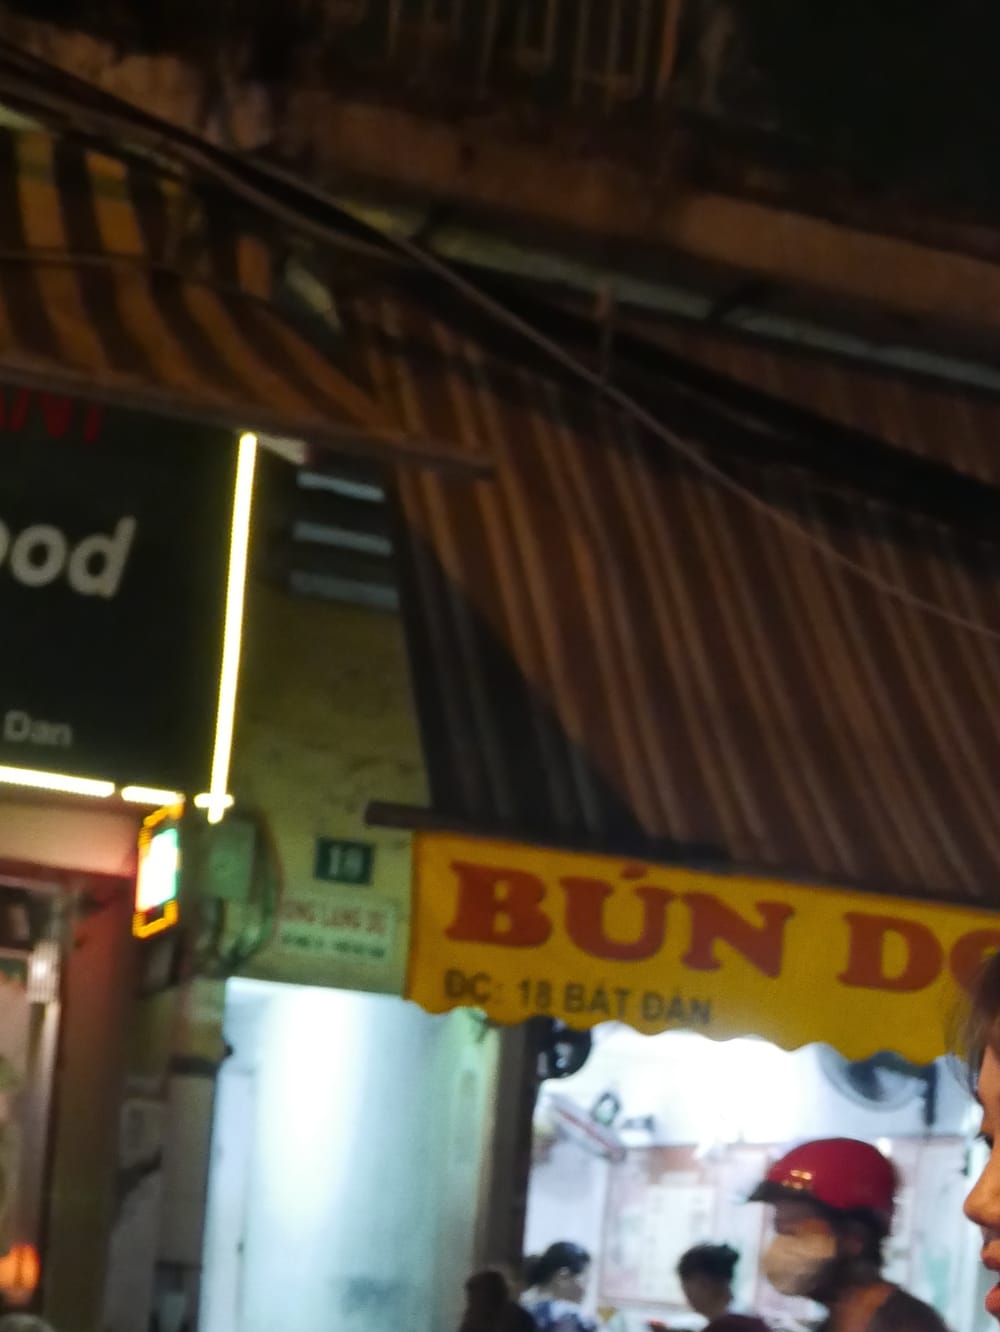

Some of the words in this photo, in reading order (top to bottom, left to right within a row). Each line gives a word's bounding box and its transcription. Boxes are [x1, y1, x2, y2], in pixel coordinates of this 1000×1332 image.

[0, 515, 137, 598] od
[445, 861, 795, 979] BÚN
[517, 976, 553, 1009] 18
